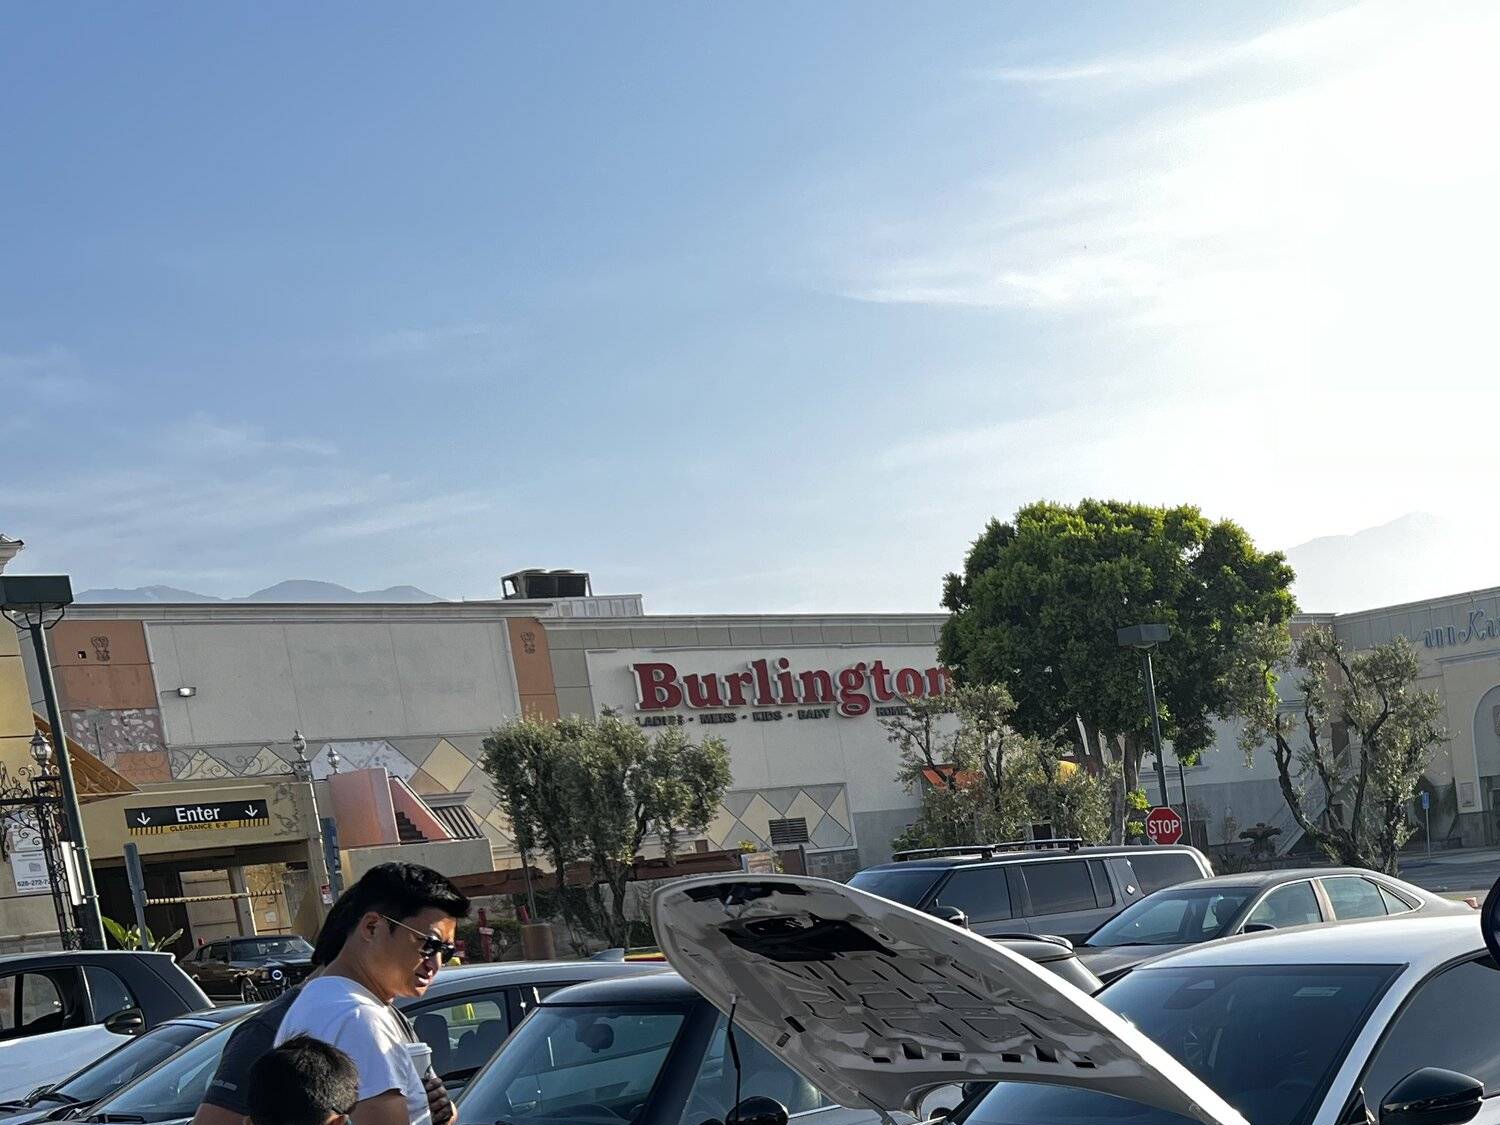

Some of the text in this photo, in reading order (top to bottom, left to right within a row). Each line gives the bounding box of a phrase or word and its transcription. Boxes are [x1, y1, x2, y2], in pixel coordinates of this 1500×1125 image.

[631, 657, 954, 716] Burlington
[699, 713, 737, 724] MENS
[752, 711, 782, 721] KIDS
[797, 708, 831, 720] BABY
[175, 806, 220, 823] Enter
[169, 823, 212, 833] CLEARANCE
[1149, 819, 1180, 834] STOP
